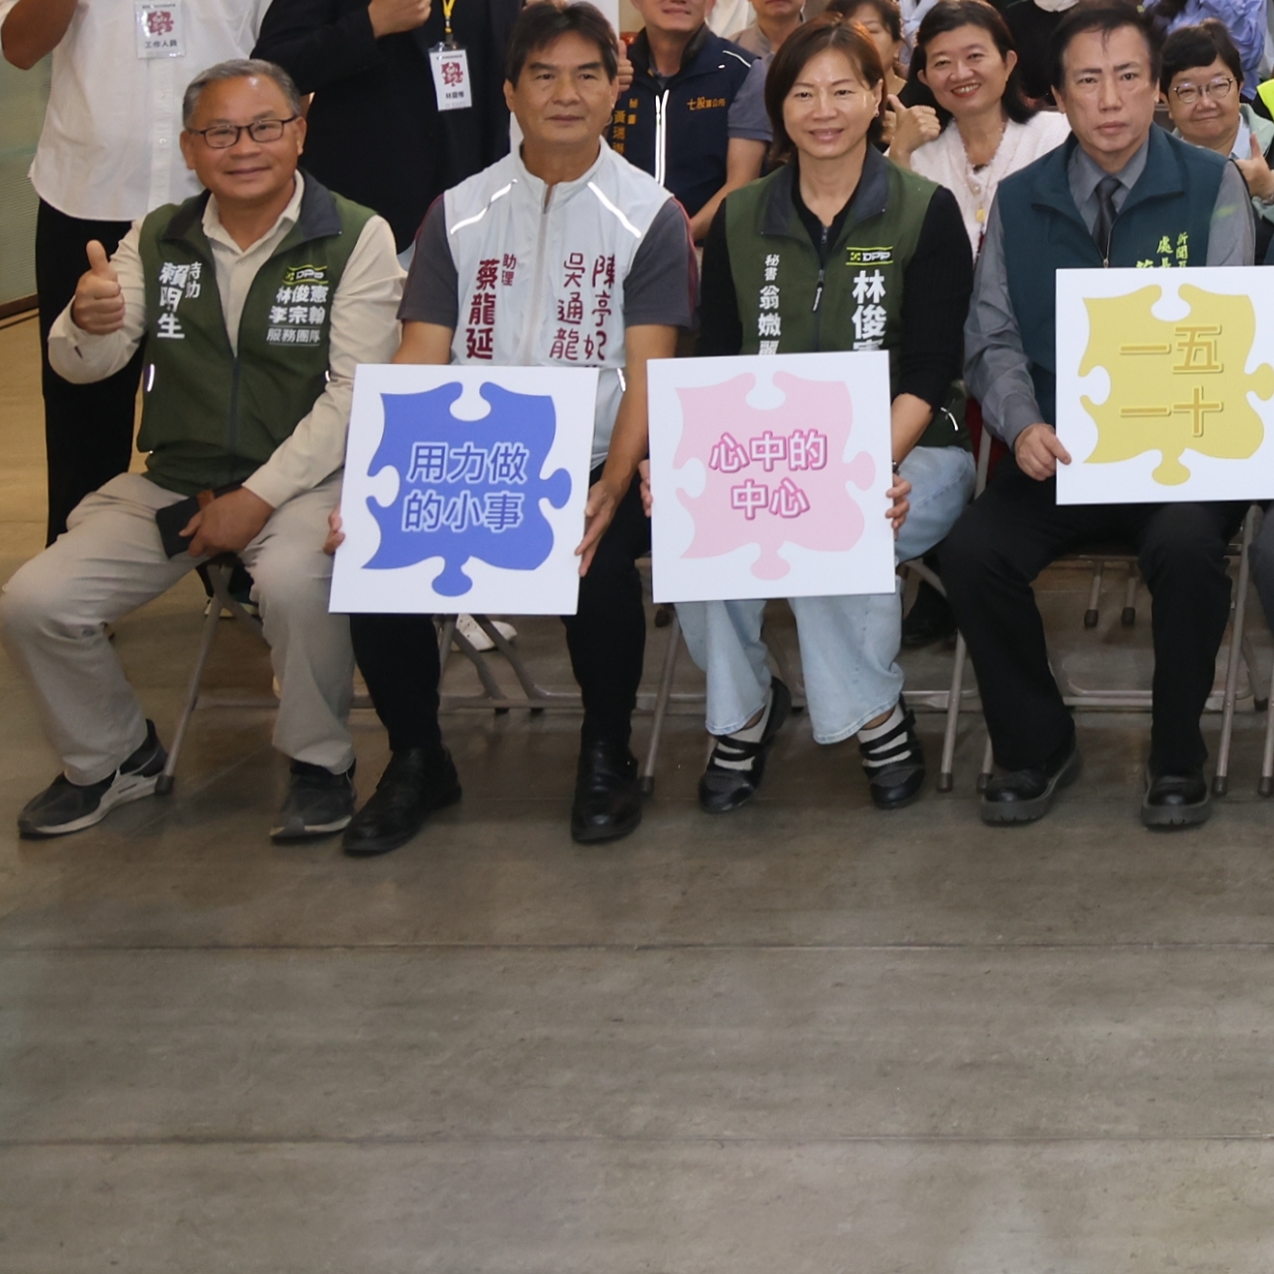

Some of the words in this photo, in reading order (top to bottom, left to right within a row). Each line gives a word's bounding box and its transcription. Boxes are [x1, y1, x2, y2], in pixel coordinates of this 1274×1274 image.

[502, 253, 518, 286] 助理
[764, 254, 780, 281] 秘書
[862, 251, 891, 262] DPP
[156, 262, 191, 339] 賴明生
[268, 306, 327, 325] 李宗翰
[275, 284, 330, 304] 林俊憲
[465, 258, 501, 360] 蔡龍延
[549, 252, 586, 360] 吳通龍
[583, 254, 616, 361] 陳亭妃
[265, 328, 322, 343] 服務團隊
[405, 441, 530, 485] 用力做
[708, 428, 828, 474] 心中的
[401, 489, 525, 534] 的小事
[730, 476, 811, 521] 中心
